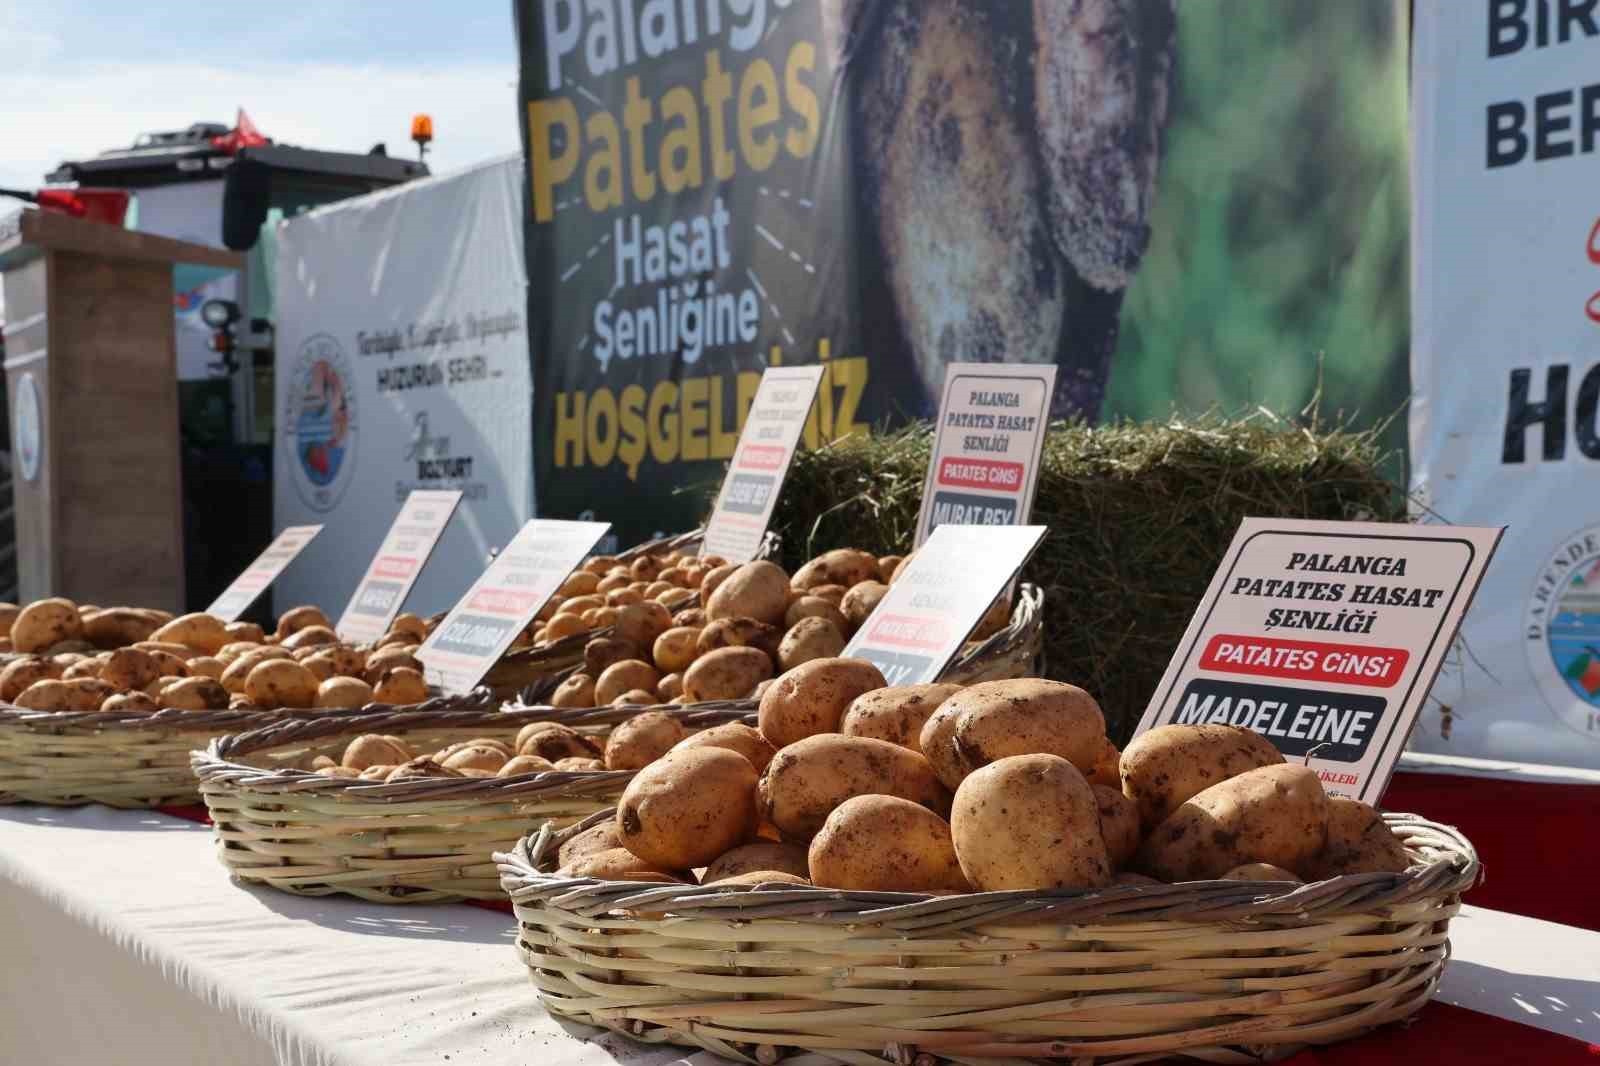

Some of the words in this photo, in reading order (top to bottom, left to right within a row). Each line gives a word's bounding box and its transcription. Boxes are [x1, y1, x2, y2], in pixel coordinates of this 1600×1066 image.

[543, 0, 792, 91] Palang
[528, 41, 820, 223] Patates
[613, 197, 732, 288] Hasat
[594, 282, 760, 373] Şenliğine
[969, 391, 1020, 407] PALANGA
[947, 412, 995, 428] PATATES
[996, 415, 1036, 431] HASAT
[944, 463, 987, 481] PATATES
[932, 501, 983, 526] MURAT
[1285, 552, 1407, 577] PALANGA
[1230, 577, 1346, 603] PATATES
[1348, 584, 1444, 609] HASAT
[1264, 607, 1377, 634] ŞENLİĞİ
[1213, 643, 1318, 671] PATATES
